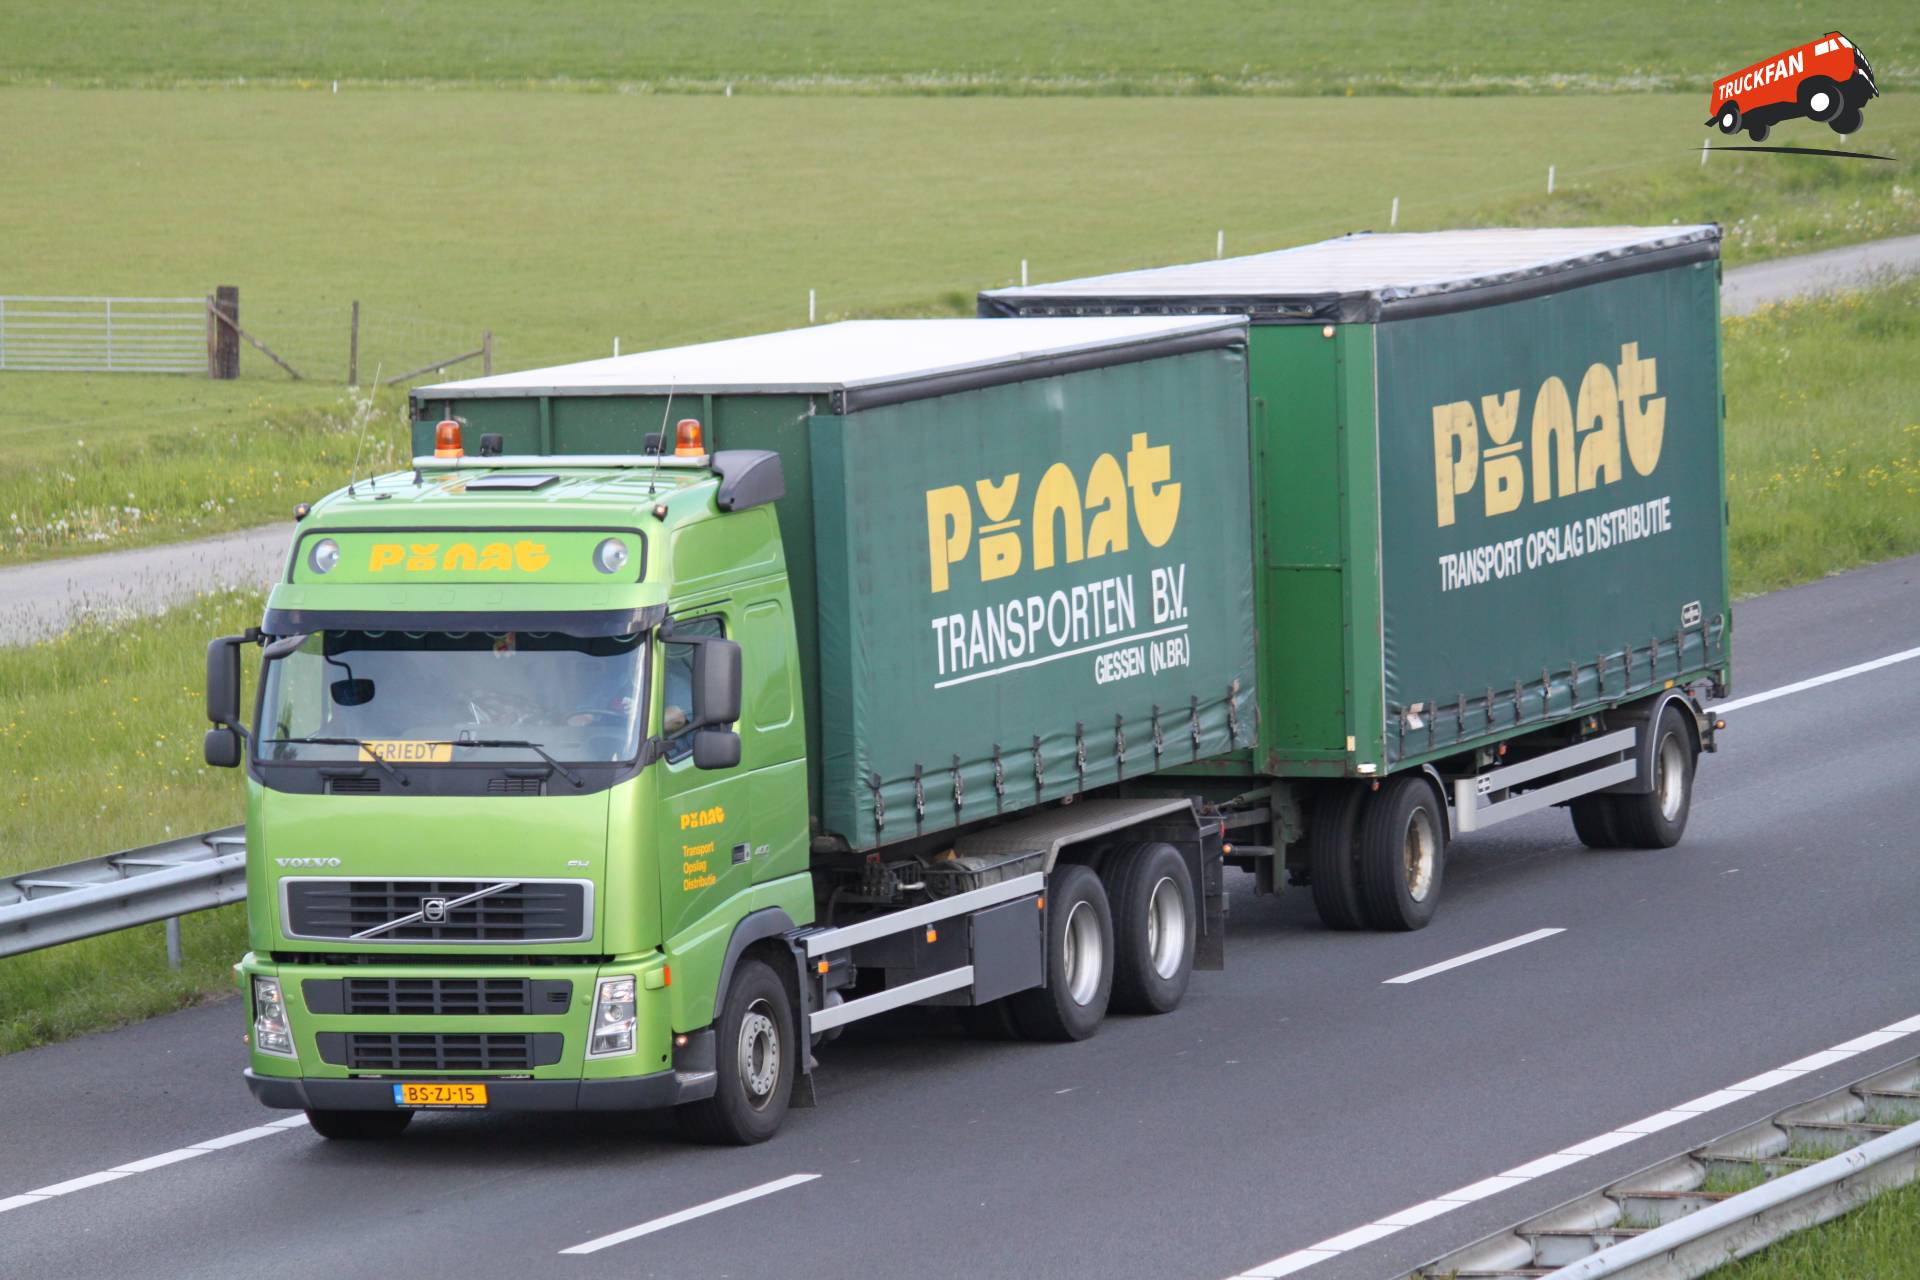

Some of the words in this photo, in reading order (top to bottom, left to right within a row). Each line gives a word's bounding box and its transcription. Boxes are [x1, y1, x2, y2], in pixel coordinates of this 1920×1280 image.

[1439, 537, 1523, 592] TRANSPORT
[1525, 520, 1584, 570] OPSLAG
[1586, 496, 1672, 553] DISTRIBUTIE
[931, 574, 1136, 675] TRANSPORTEN
[1151, 563, 1188, 625] B.V.
[1150, 633, 1190, 676] (N.BR.)
[374, 743, 437, 760] GRIEDY
[682, 842, 715, 857] Transport
[275, 857, 341, 868] VOLVO
[683, 861, 707, 877] Opslag
[408, 1087, 475, 1101] BS-ZJ-15
